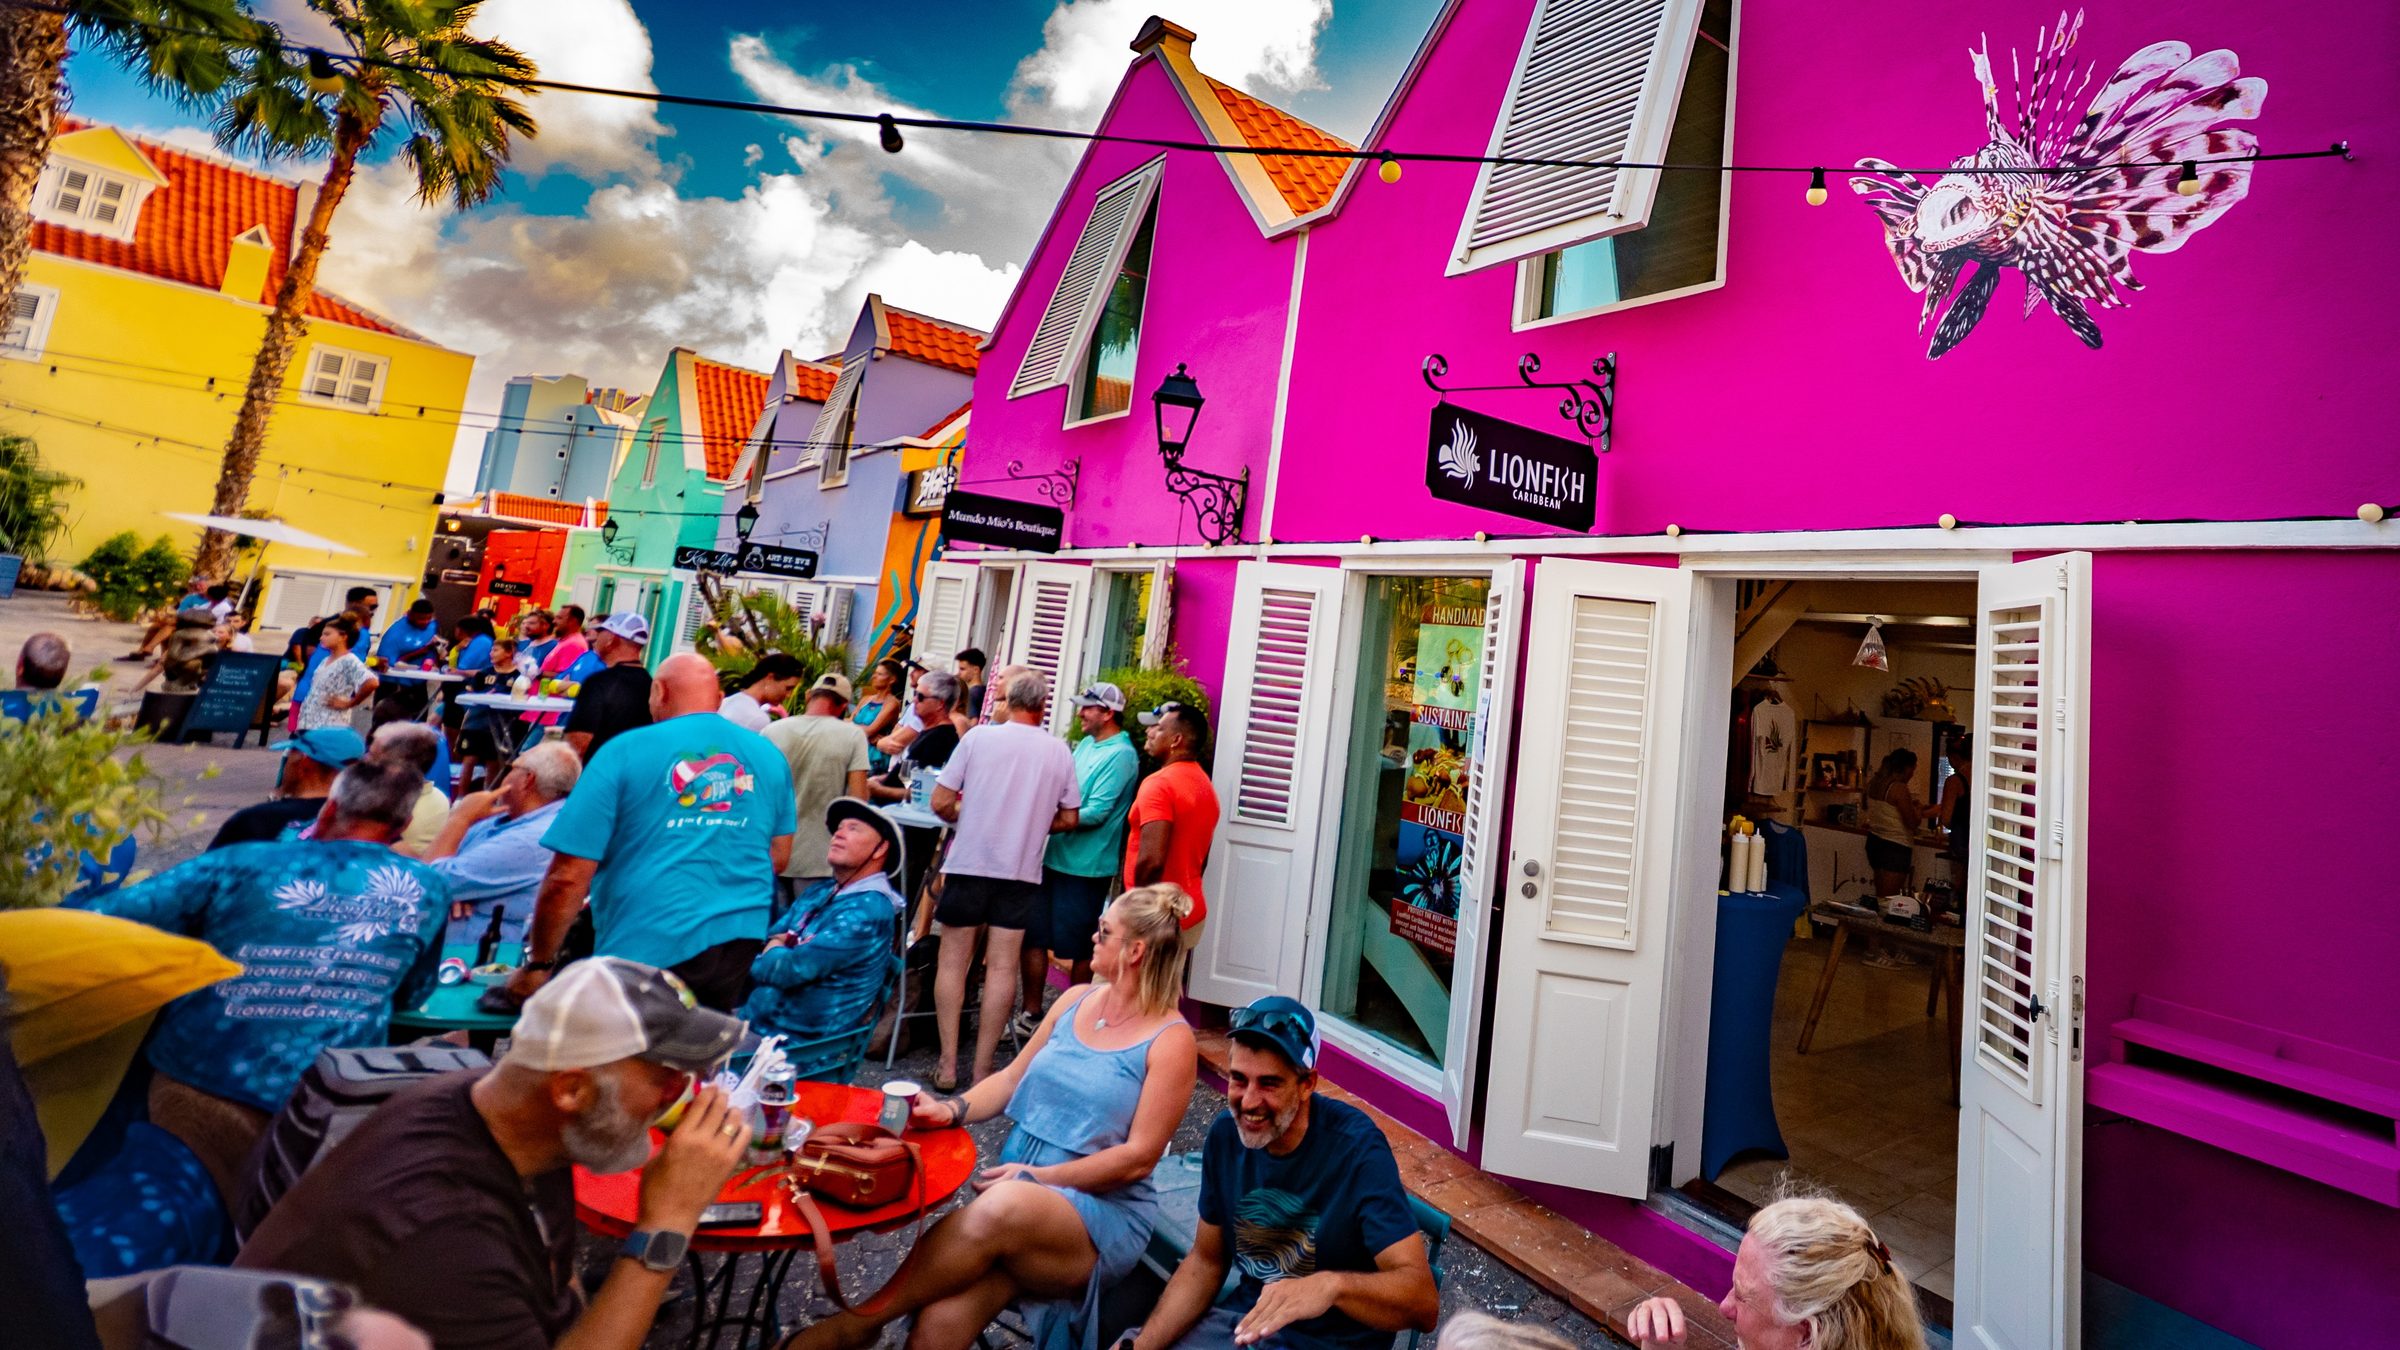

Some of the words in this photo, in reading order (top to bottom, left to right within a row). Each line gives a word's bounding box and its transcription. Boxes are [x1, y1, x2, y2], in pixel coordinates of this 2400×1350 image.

[1489, 449, 1585, 503] LIONFISH
[1513, 489, 1561, 509] CARIBBEAN
[948, 510, 985, 524] Mundo
[987, 516, 1013, 529] Mio's
[1015, 520, 1057, 536] Boutique
[1432, 606, 1486, 626] HANDMAD
[1408, 906, 1424, 916] PROTECT
[1411, 916, 1430, 926] Caribbean
